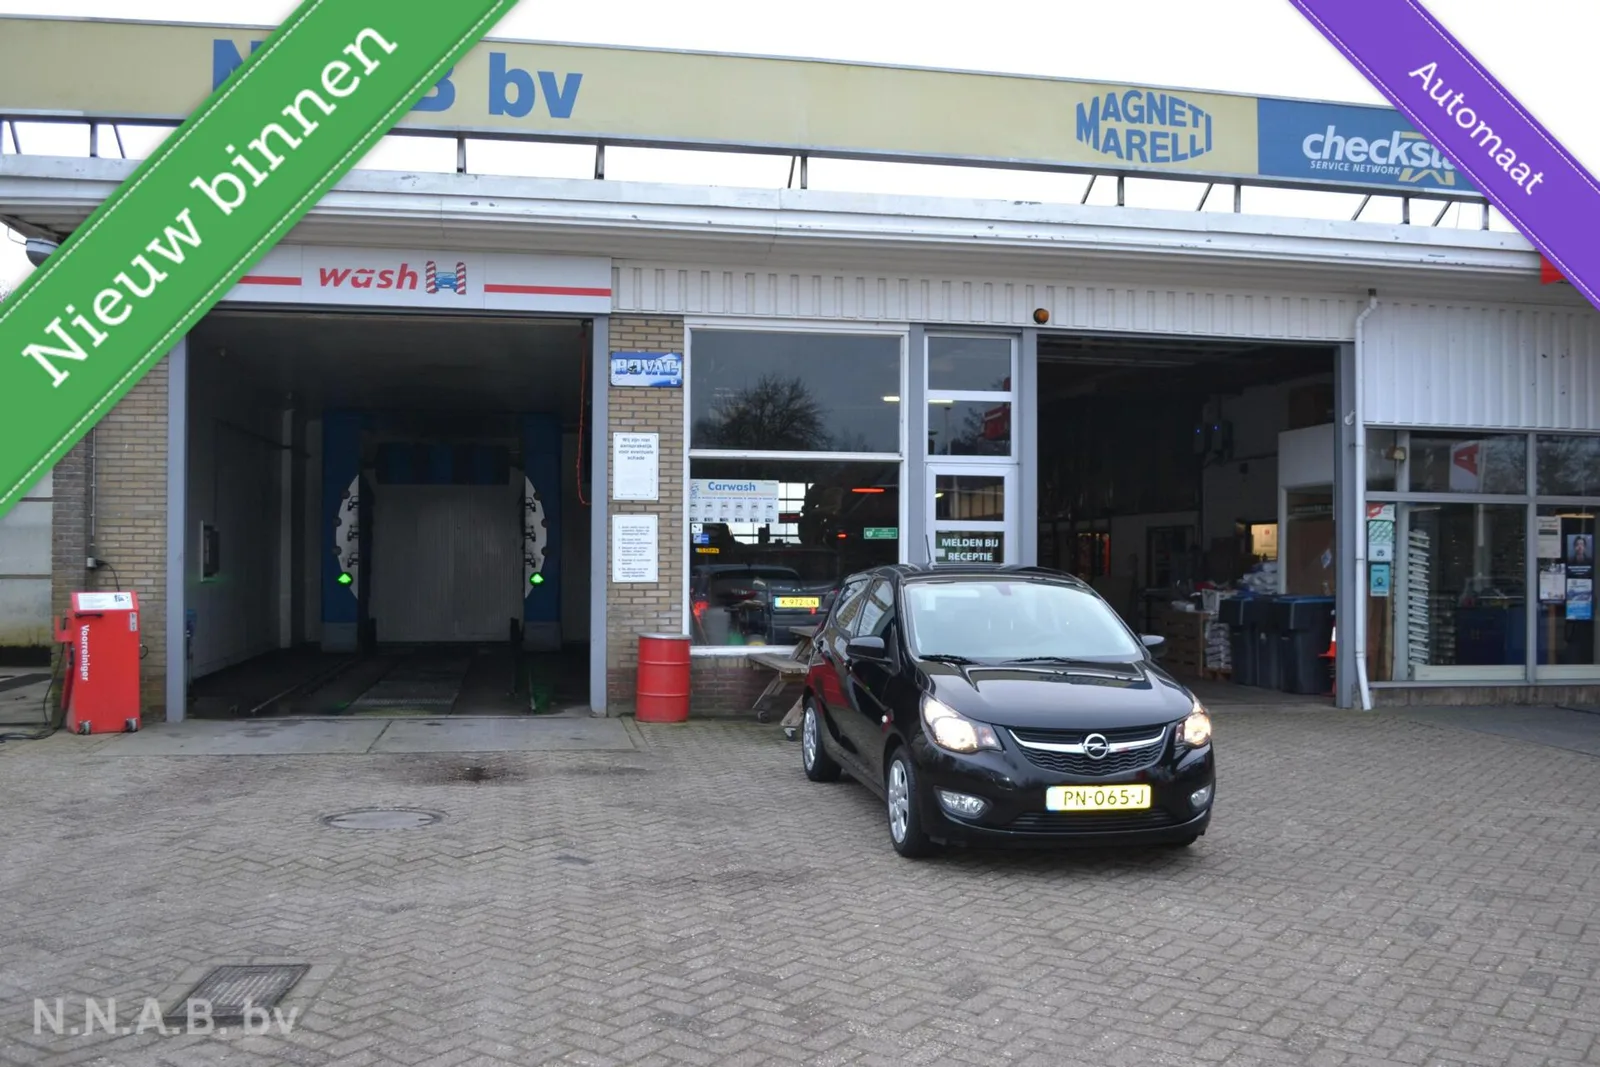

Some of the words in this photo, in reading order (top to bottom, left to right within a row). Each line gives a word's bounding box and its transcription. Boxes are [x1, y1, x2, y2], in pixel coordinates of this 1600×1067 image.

[488, 52, 584, 119] bv
[1076, 90, 1212, 141] MAGNETI
[1076, 112, 1212, 163] MARELLI
[1310, 160, 1350, 172] SERVICE
[1352, 164, 1400, 176] NETWORK
[319, 263, 418, 290] wash
[708, 481, 756, 491] Carwash
[941, 538, 983, 548] MELDEN
[985, 539, 999, 548] BIJ
[948, 552, 993, 561] RECEPTIE
[81, 624, 90, 681] Voorreiniger
[1063, 789, 1145, 806] PN-065-J
